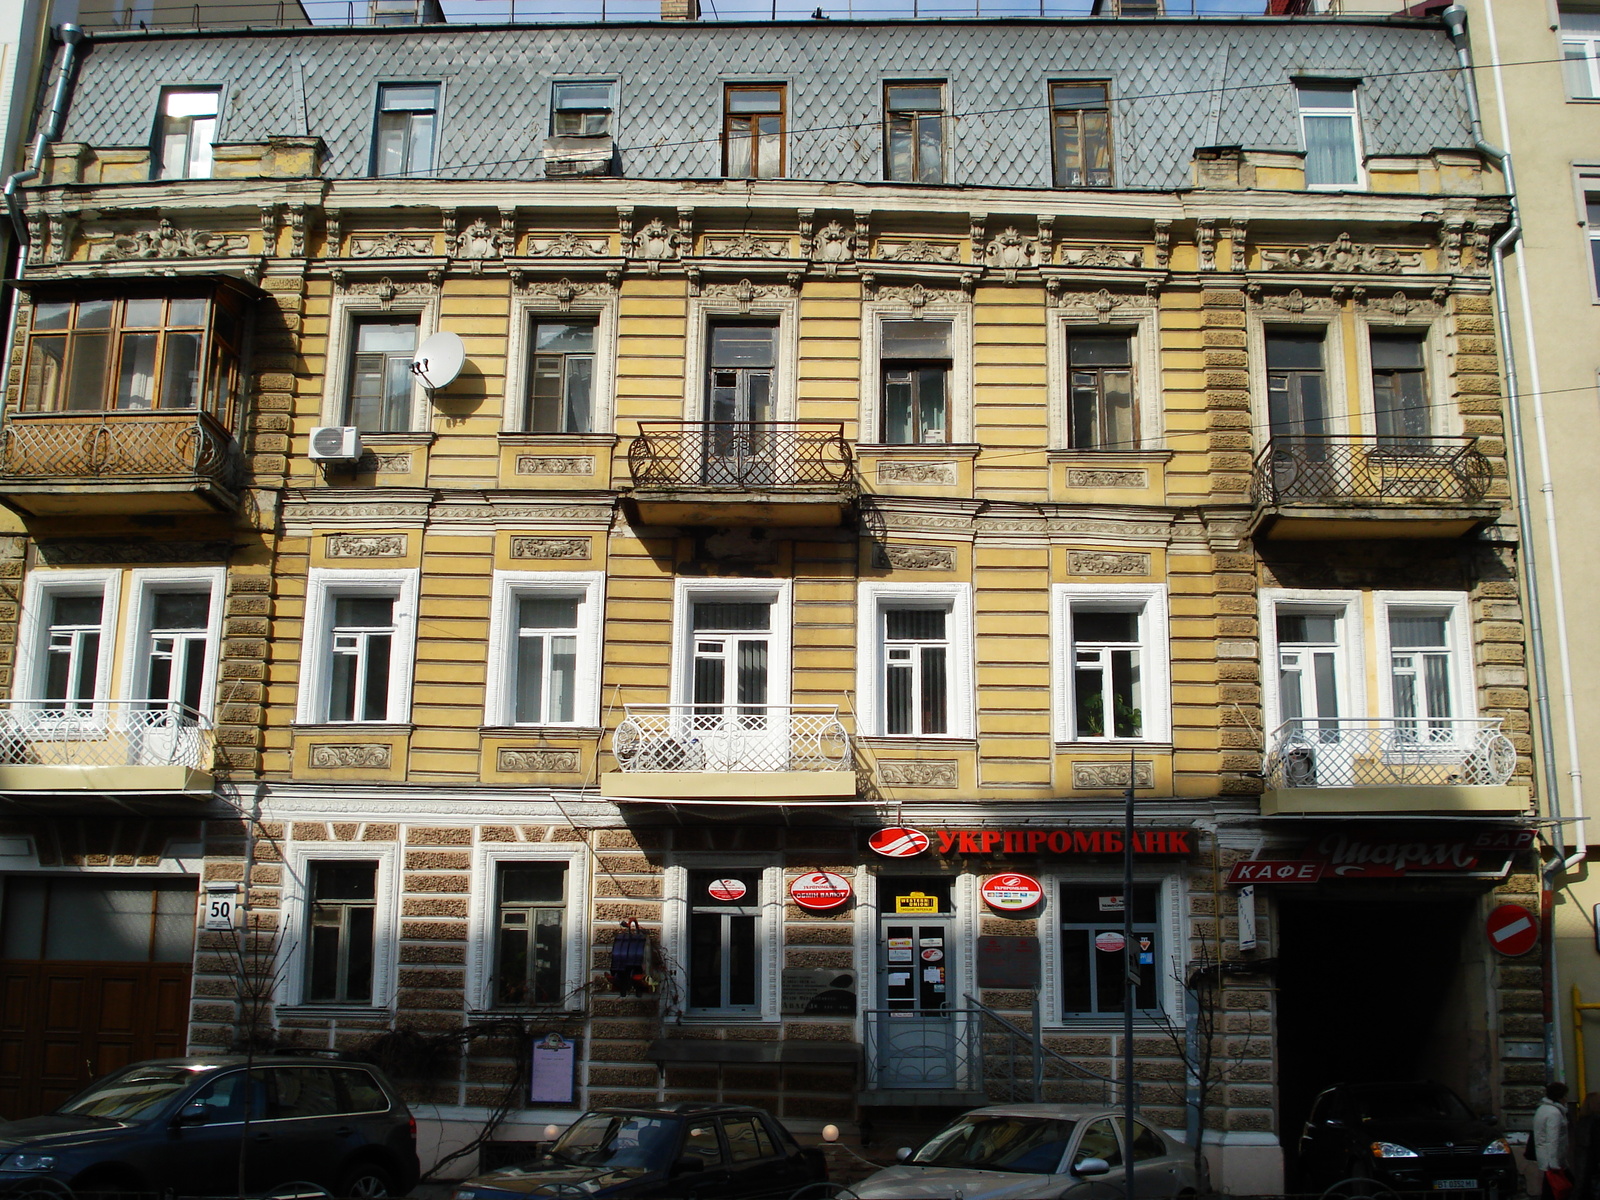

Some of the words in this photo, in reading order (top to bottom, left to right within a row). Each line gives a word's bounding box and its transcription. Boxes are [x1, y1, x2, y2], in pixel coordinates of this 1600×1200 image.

[935, 830, 1191, 853] УКРПРОМБАНК
[1475, 832, 1532, 846] БАР
[1318, 832, 1474, 873] Шарм
[1237, 864, 1316, 879] КАФЕ
[210, 901, 230, 917] 50
